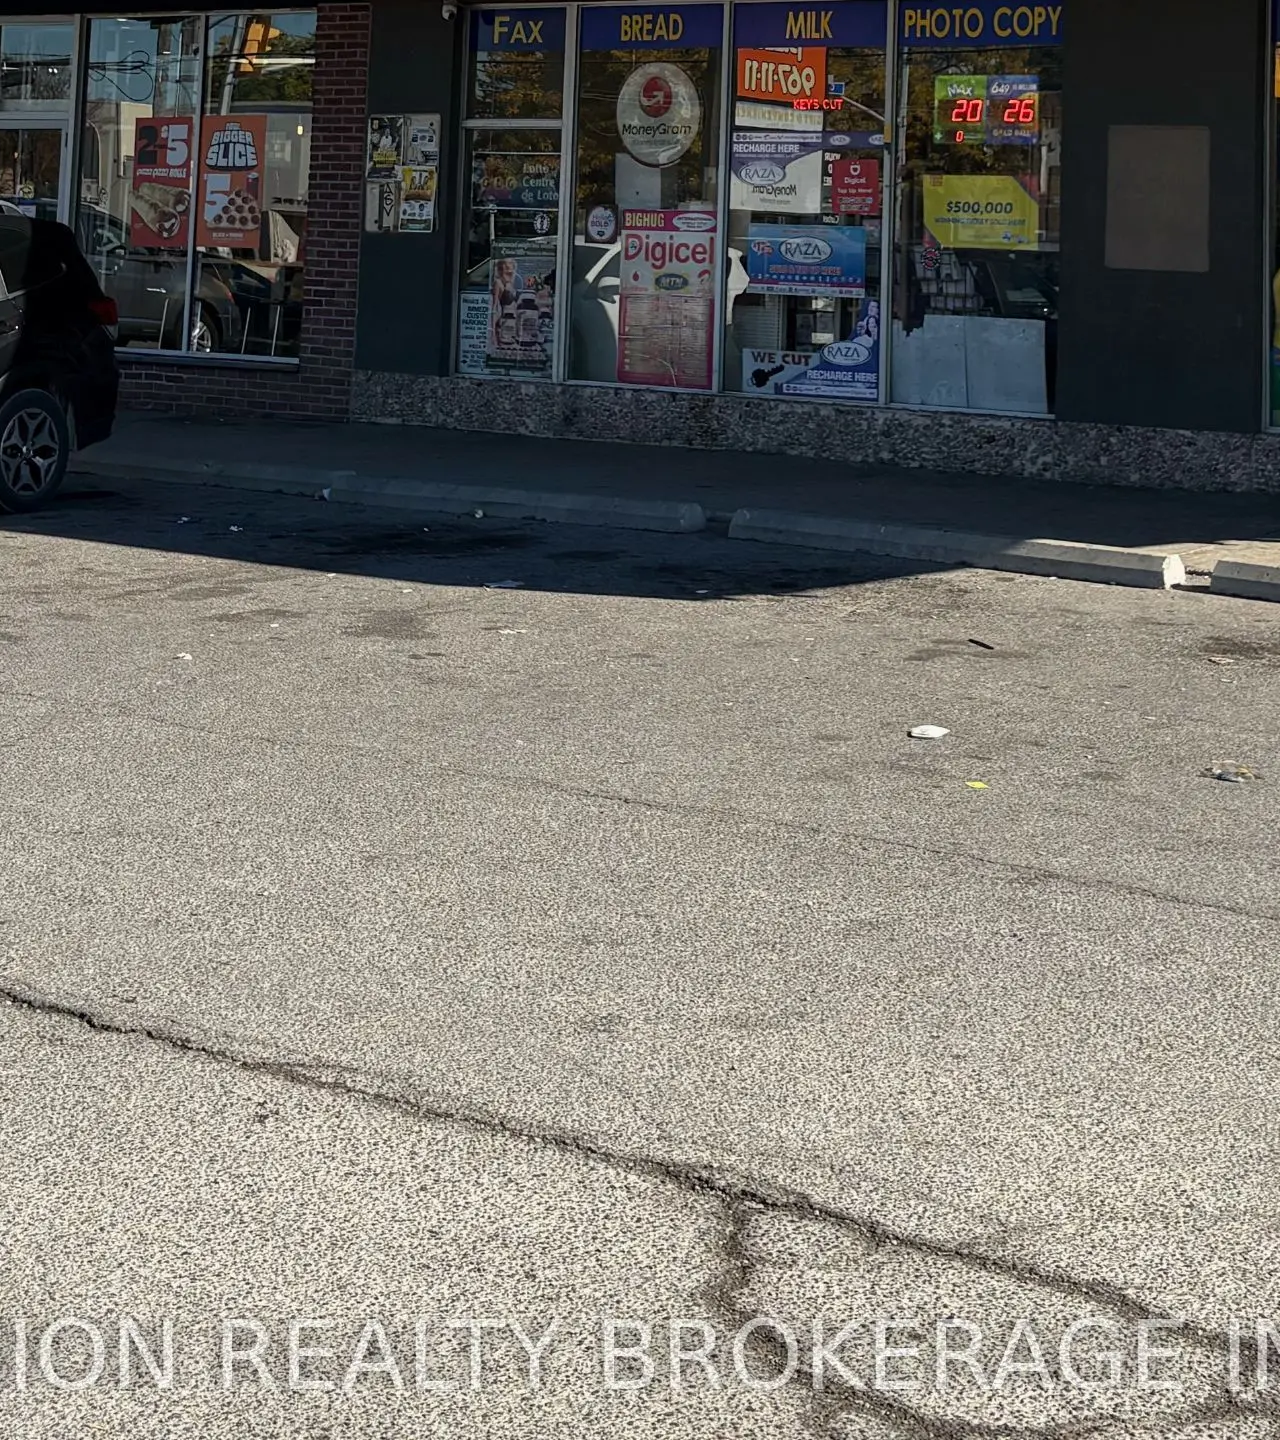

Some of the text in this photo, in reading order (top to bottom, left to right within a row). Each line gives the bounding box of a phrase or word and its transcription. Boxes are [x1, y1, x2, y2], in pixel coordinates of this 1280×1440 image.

[493, 15, 543, 44] FAX
[620, 13, 683, 42] BREAD
[786, 11, 834, 40] MILK
[904, 5, 1063, 39] PHOTO COPY
[793, 98, 844, 110] KEYS CUT
[951, 99, 983, 122] 20
[1003, 99, 1034, 122] 26
[211, 130, 254, 146] BIGGER
[622, 123, 692, 138] MoneyGram
[206, 142, 258, 167] SLICE
[733, 143, 801, 153] RECHARGE HERE
[744, 166, 776, 181] RAZA
[946, 200, 1014, 215] $500,000
[625, 212, 665, 228] BIGHUG
[624, 233, 714, 270] Digicel
[784, 242, 821, 258] RAZA
[751, 351, 812, 366] WE CUT
[827, 346, 860, 359] RAZA
[806, 369, 878, 382] RECHARGE HERE
